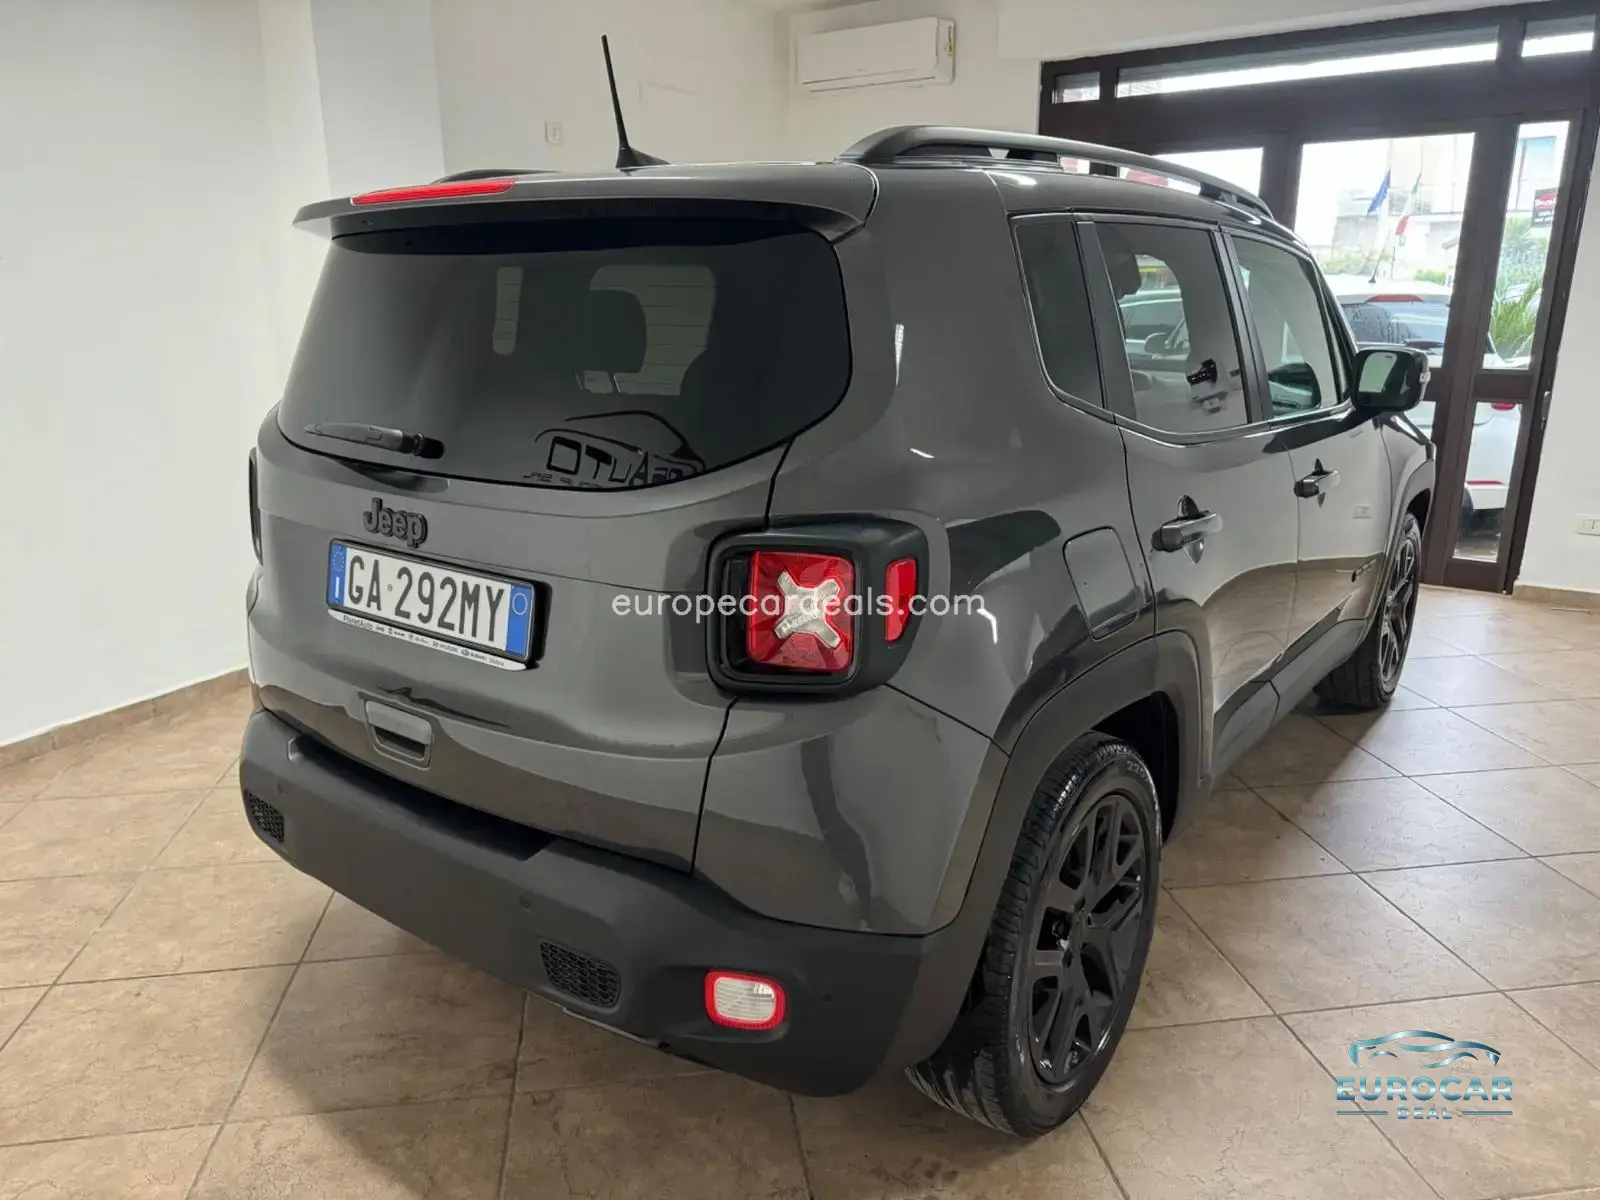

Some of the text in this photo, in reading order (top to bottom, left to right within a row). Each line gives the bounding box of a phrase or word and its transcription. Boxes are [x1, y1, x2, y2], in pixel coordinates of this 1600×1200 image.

[363, 497, 428, 549] Jeep
[348, 555, 505, 642] GA 292MY
